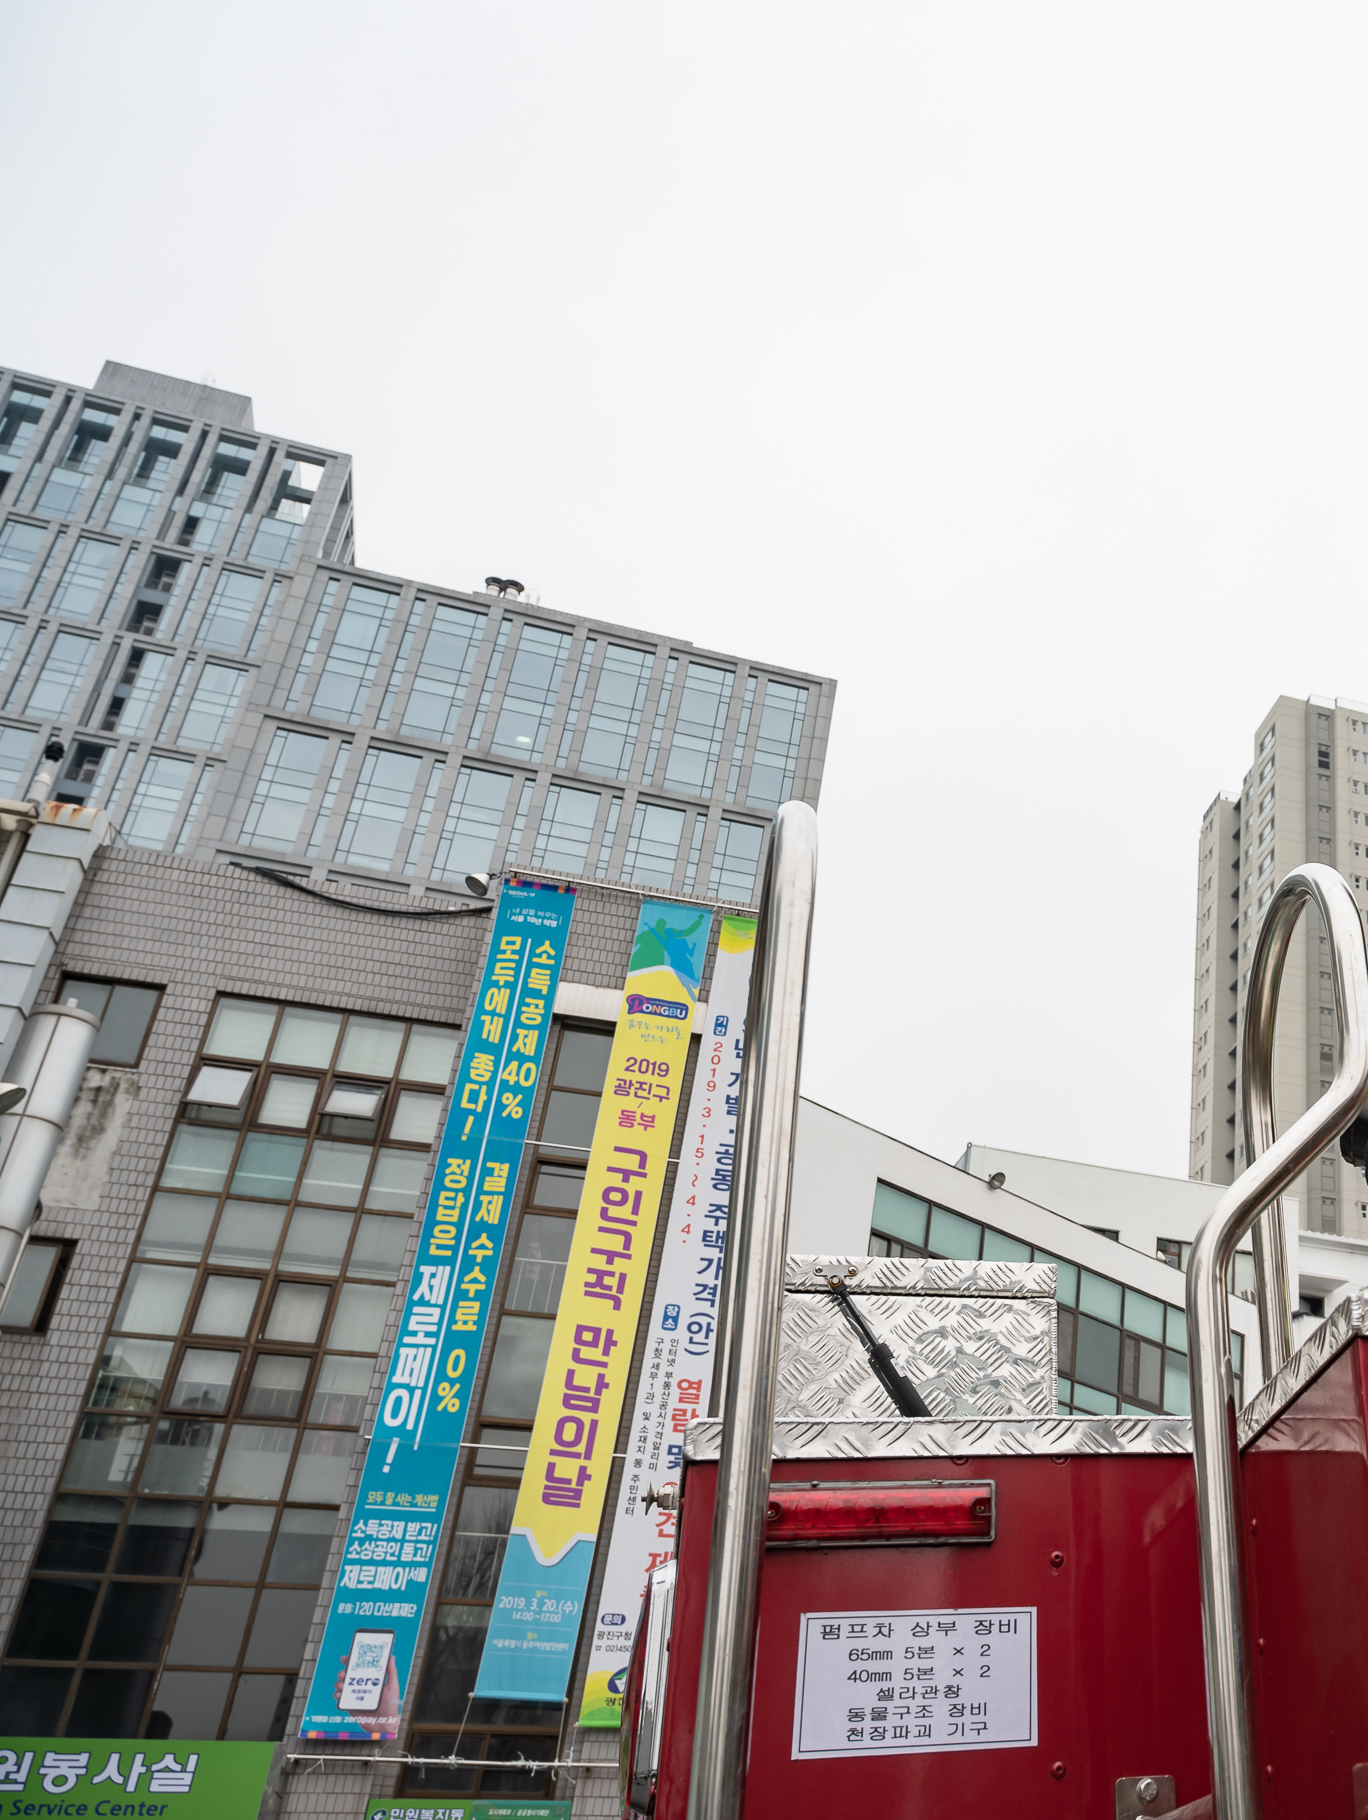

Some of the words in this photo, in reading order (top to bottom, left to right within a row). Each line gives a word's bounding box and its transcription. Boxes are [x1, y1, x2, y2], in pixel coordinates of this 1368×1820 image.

[510, 914, 525, 923] 서울
[526, 916, 542, 926] 10년
[481, 935, 523, 1044] 모두에게
[512, 939, 557, 1057] 소득공제
[626, 994, 687, 1019] DONGBU
[715, 1016, 728, 1036] 기간
[623, 1055, 671, 1079] 2019
[612, 1077, 671, 1103] 광진구
[617, 1108, 656, 1132] 동부
[475, 1161, 511, 1225] 결제
[428, 1157, 472, 1257] 정답은
[583, 1145, 648, 1311] 구인구직
[451, 1232, 494, 1332] 수수료
[662, 1305, 679, 1329] 장소
[666, 1338, 680, 1368] 인터넷
[642, 1411, 652, 1422] 및
[636, 1424, 650, 1455] 소재지
[366, 1490, 384, 1505] 모두
[385, 1491, 395, 1506] 잘
[395, 1492, 412, 1506] 사는
[412, 1493, 439, 1508] 계산법
[625, 1473, 640, 1517] 주민센터
[351, 1519, 406, 1540] 소득공제
[405, 1521, 438, 1541] 받고!
[346, 1540, 401, 1562] 소상공인
[400, 1542, 433, 1562] 돕고!
[340, 1564, 410, 1591] 제로페이
[408, 1566, 429, 1583] 서울
[354, 1601, 374, 1616] 120
[373, 1602, 418, 1618] 다산콜재단
[498, 1595, 527, 1611] 2019.
[603, 1613, 623, 1625] 문의
[820, 1621, 895, 1641] 펌프차
[909, 1619, 958, 1638] 상부
[973, 1617, 1019, 1636] 장비
[596, 1629, 633, 1641] 광진구청
[848, 1647, 894, 1662] 65mm
[903, 1645, 936, 1660] 5본
[979, 1643, 992, 1658] 2
[846, 1669, 893, 1683] 40mm
[902, 1666, 936, 1682] 5본
[979, 1665, 991, 1679] 2
[343, 1715, 398, 1725] zeropay.or.kr
[846, 1704, 934, 1723] 동물구조
[947, 1701, 988, 1718] 장비
[845, 1723, 932, 1743] 천장파괴
[946, 1721, 989, 1738] 기구
[9, 1799, 89, 1817] Service
[93, 1799, 169, 1817] Center
